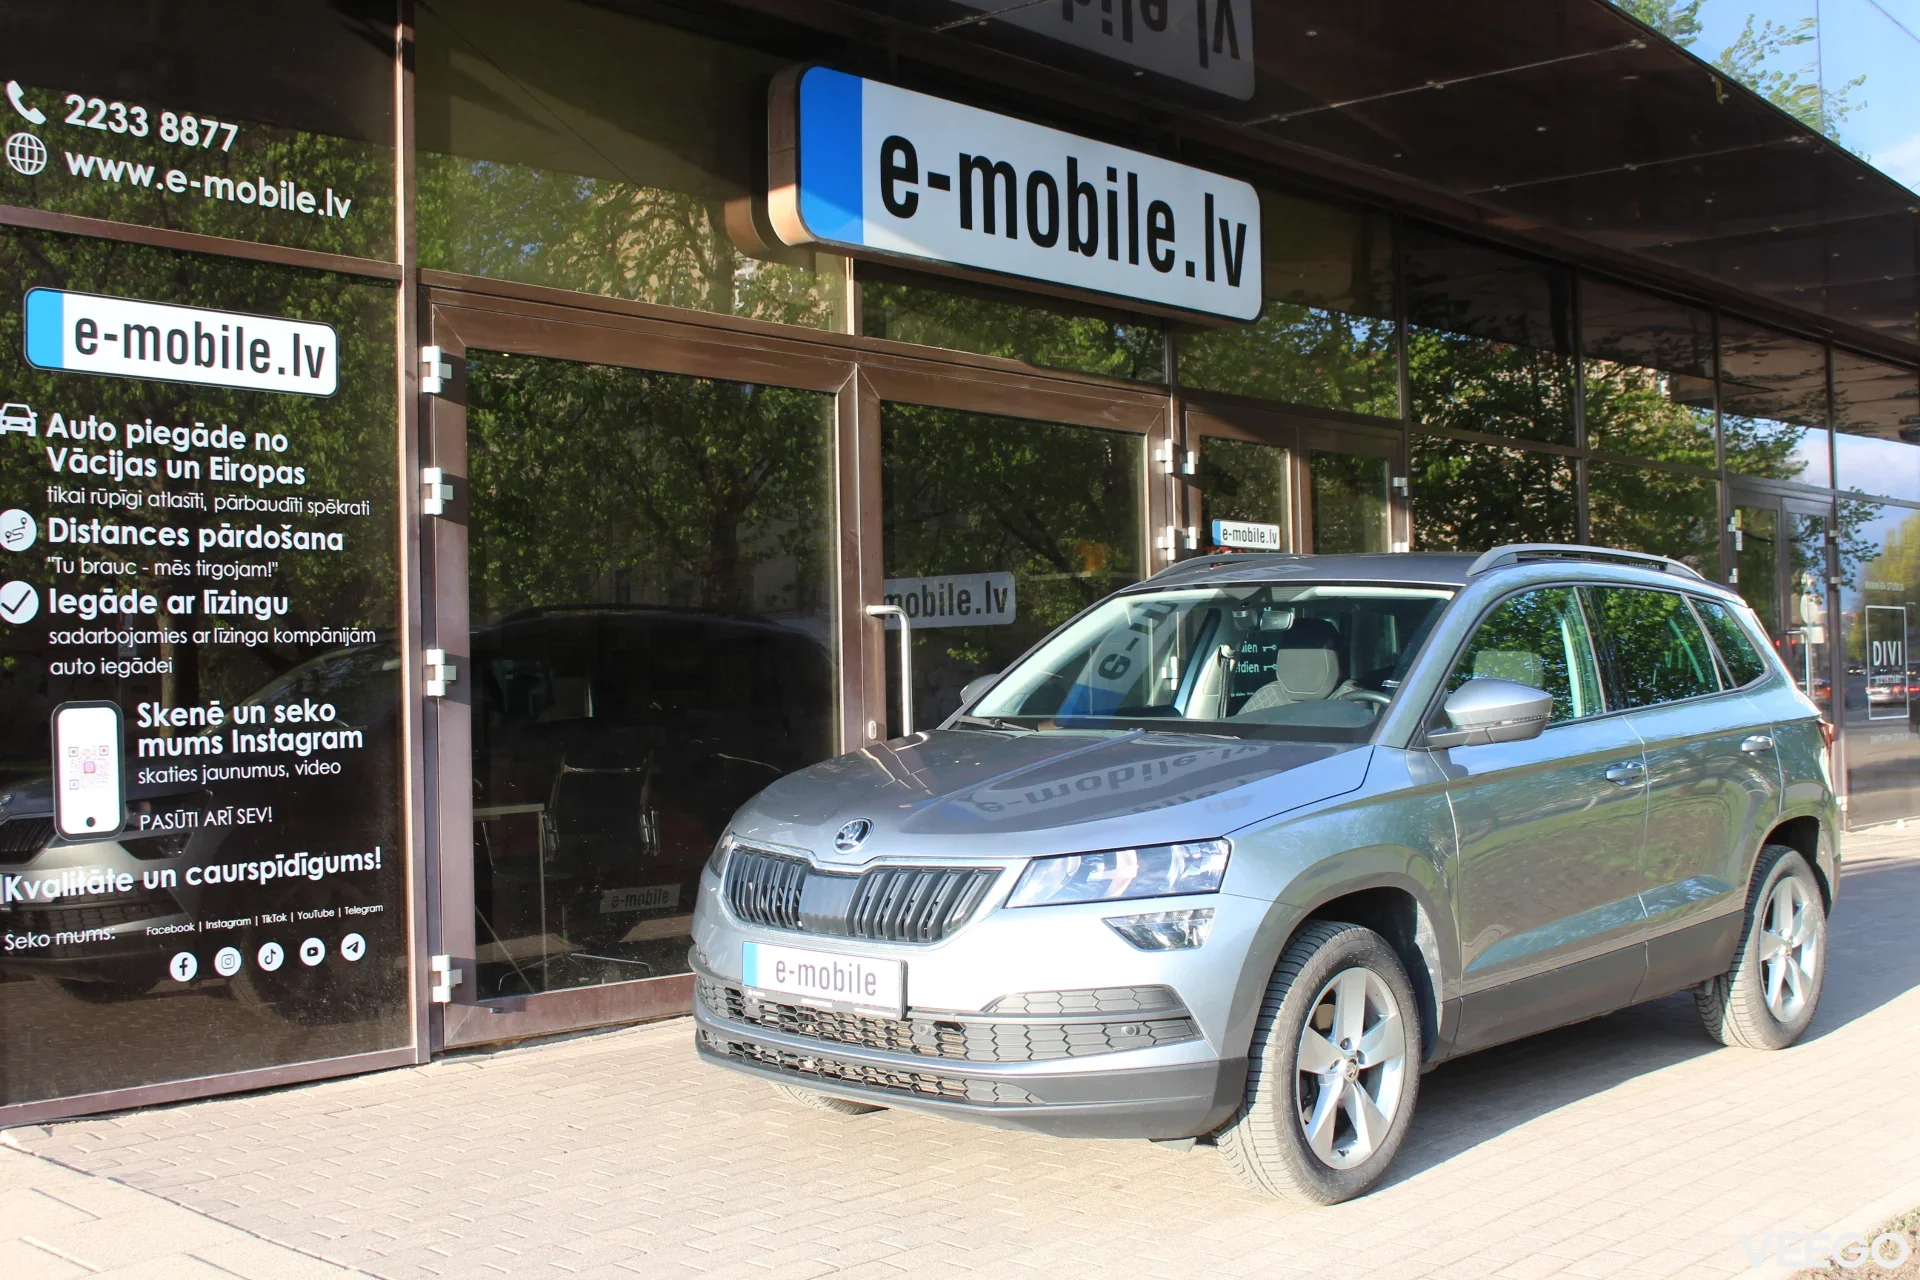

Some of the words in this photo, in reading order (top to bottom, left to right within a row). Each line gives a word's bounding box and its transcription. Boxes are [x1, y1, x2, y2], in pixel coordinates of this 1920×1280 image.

[64, 94, 149, 138] 2233
[159, 111, 239, 153] 8877
[64, 151, 352, 219] www.e-mobile.lv
[879, 134, 1247, 289] e-mobile.lv
[75, 316, 326, 379] e-mobile.lv
[46, 412, 117, 442] Auto
[126, 418, 246, 453] piegāde
[255, 432, 288, 453] no
[46, 446, 157, 482] Vācijas
[166, 458, 200, 480] un
[209, 456, 306, 489] Eiropas
[47, 486, 86, 505] tikai
[90, 489, 143, 511] rūpīgi
[147, 490, 208, 512] atlasīti,
[214, 493, 303, 517] pārbaudīti
[307, 498, 371, 518] spēkrati
[48, 517, 190, 547] Distances
[199, 522, 344, 553] pārdošana
[1222, 527, 1277, 544] e-mobile.lv
[47, 556, 75, 575] "Tu
[80, 557, 137, 575] brauc
[154, 558, 191, 577] mēs
[195, 558, 279, 581] tirgojam!"
[49, 587, 158, 620] Iegāde
[166, 594, 195, 616] ar
[204, 589, 288, 621] līzingu
[884, 581, 1008, 619] mobile.lv
[49, 627, 188, 649] sadarbojamies
[192, 629, 210, 644] ar
[213, 626, 269, 648] līzinga
[273, 626, 376, 649] kompānijām
[1872, 641, 1902, 666] DIVI
[50, 656, 96, 676] auto
[100, 656, 173, 680] iegādei
[137, 699, 225, 729] Skenē
[233, 704, 267, 725] un
[274, 698, 336, 725] seko
[138, 732, 224, 758] mums
[232, 727, 364, 759] Instagram
[138, 765, 198, 785] skaties
[201, 763, 290, 784] jaunumus,
[294, 760, 342, 777] video
[140, 809, 199, 831] PASŪTI
[204, 806, 233, 828] ARĪ
[237, 806, 273, 826] SEV!
[5, 867, 134, 903] Kvalitāte
[143, 867, 177, 890] un
[185, 846, 382, 885] caurspīdīgums!
[146, 922, 196, 936] Facebook
[205, 916, 252, 930] Instagram
[261, 912, 288, 924] TikTok
[297, 908, 335, 920] YouTube
[344, 904, 384, 916] Telegram
[4, 930, 51, 951] Seko
[55, 926, 117, 946] mums:
[775, 958, 877, 997] e-mobile
